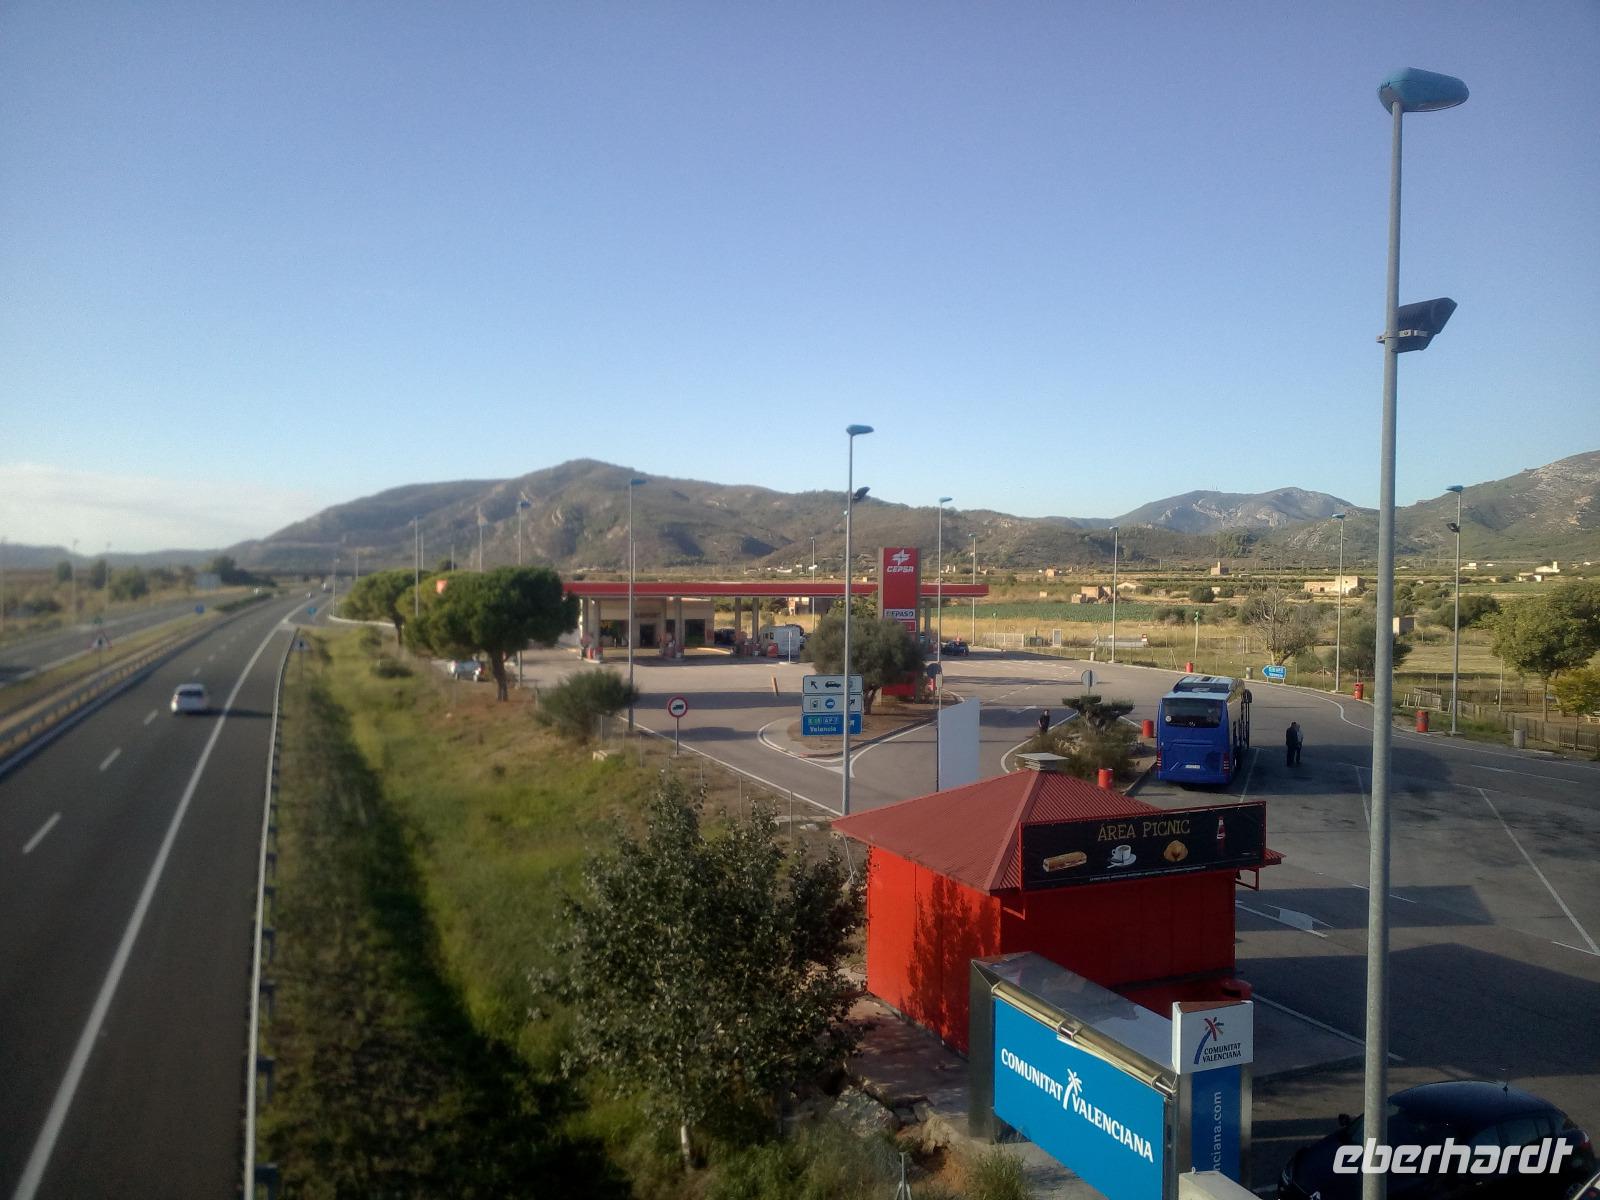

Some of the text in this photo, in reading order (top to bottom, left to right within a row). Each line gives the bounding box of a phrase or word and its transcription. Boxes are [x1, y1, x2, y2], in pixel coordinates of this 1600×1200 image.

[886, 565, 914, 573] CEPSA
[1097, 819, 1191, 841] ÁREA PICNIC
[1204, 1042, 1241, 1056] COMUNITAT
[1202, 1050, 1242, 1063] VALENCIANA
[1001, 1048, 1154, 1163] COMUNITAT VALENCIANA
